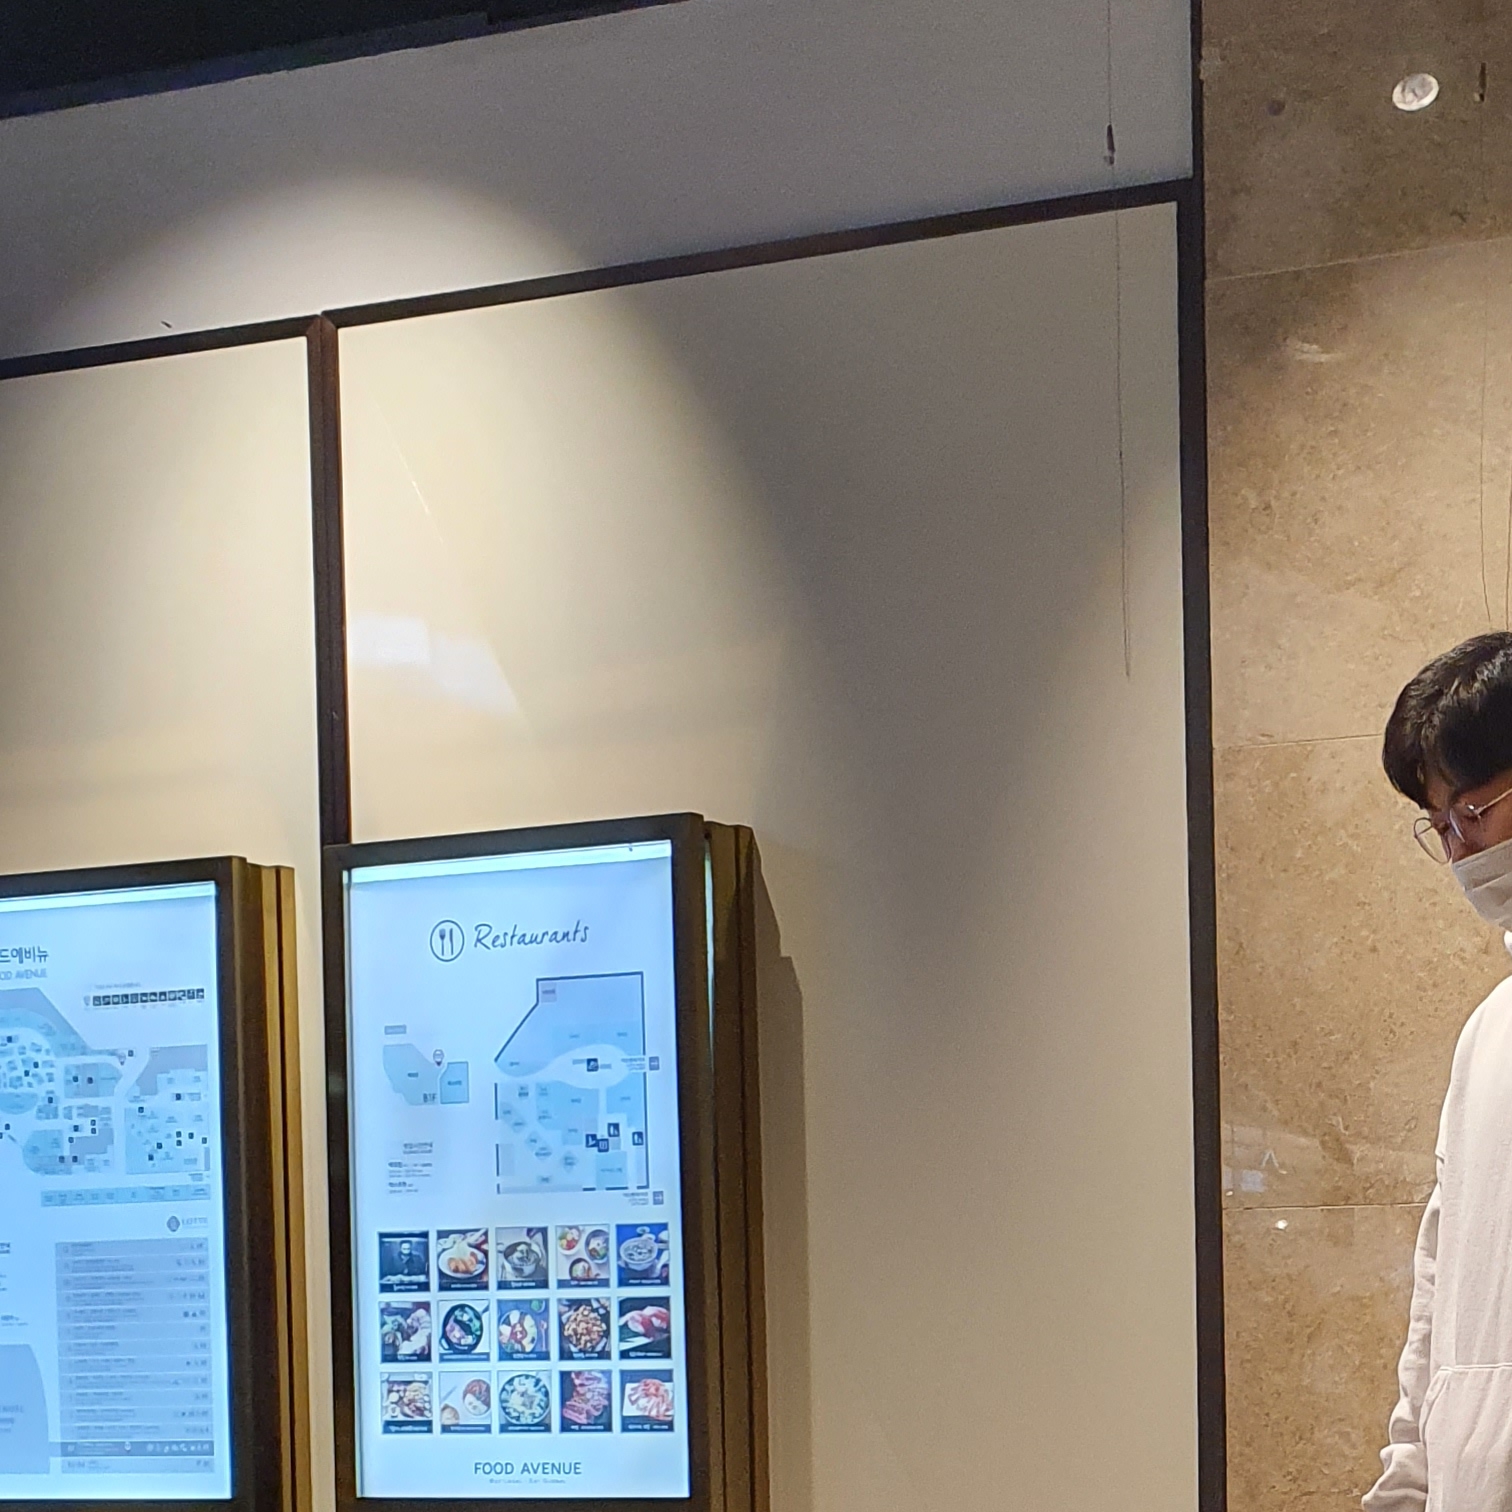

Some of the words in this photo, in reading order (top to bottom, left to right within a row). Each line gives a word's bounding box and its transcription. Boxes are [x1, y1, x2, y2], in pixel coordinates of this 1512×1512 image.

[474, 920, 589, 950] Restaurants
[474, 1462, 514, 1475] FOOD
[520, 1462, 582, 1475] AVENUE
